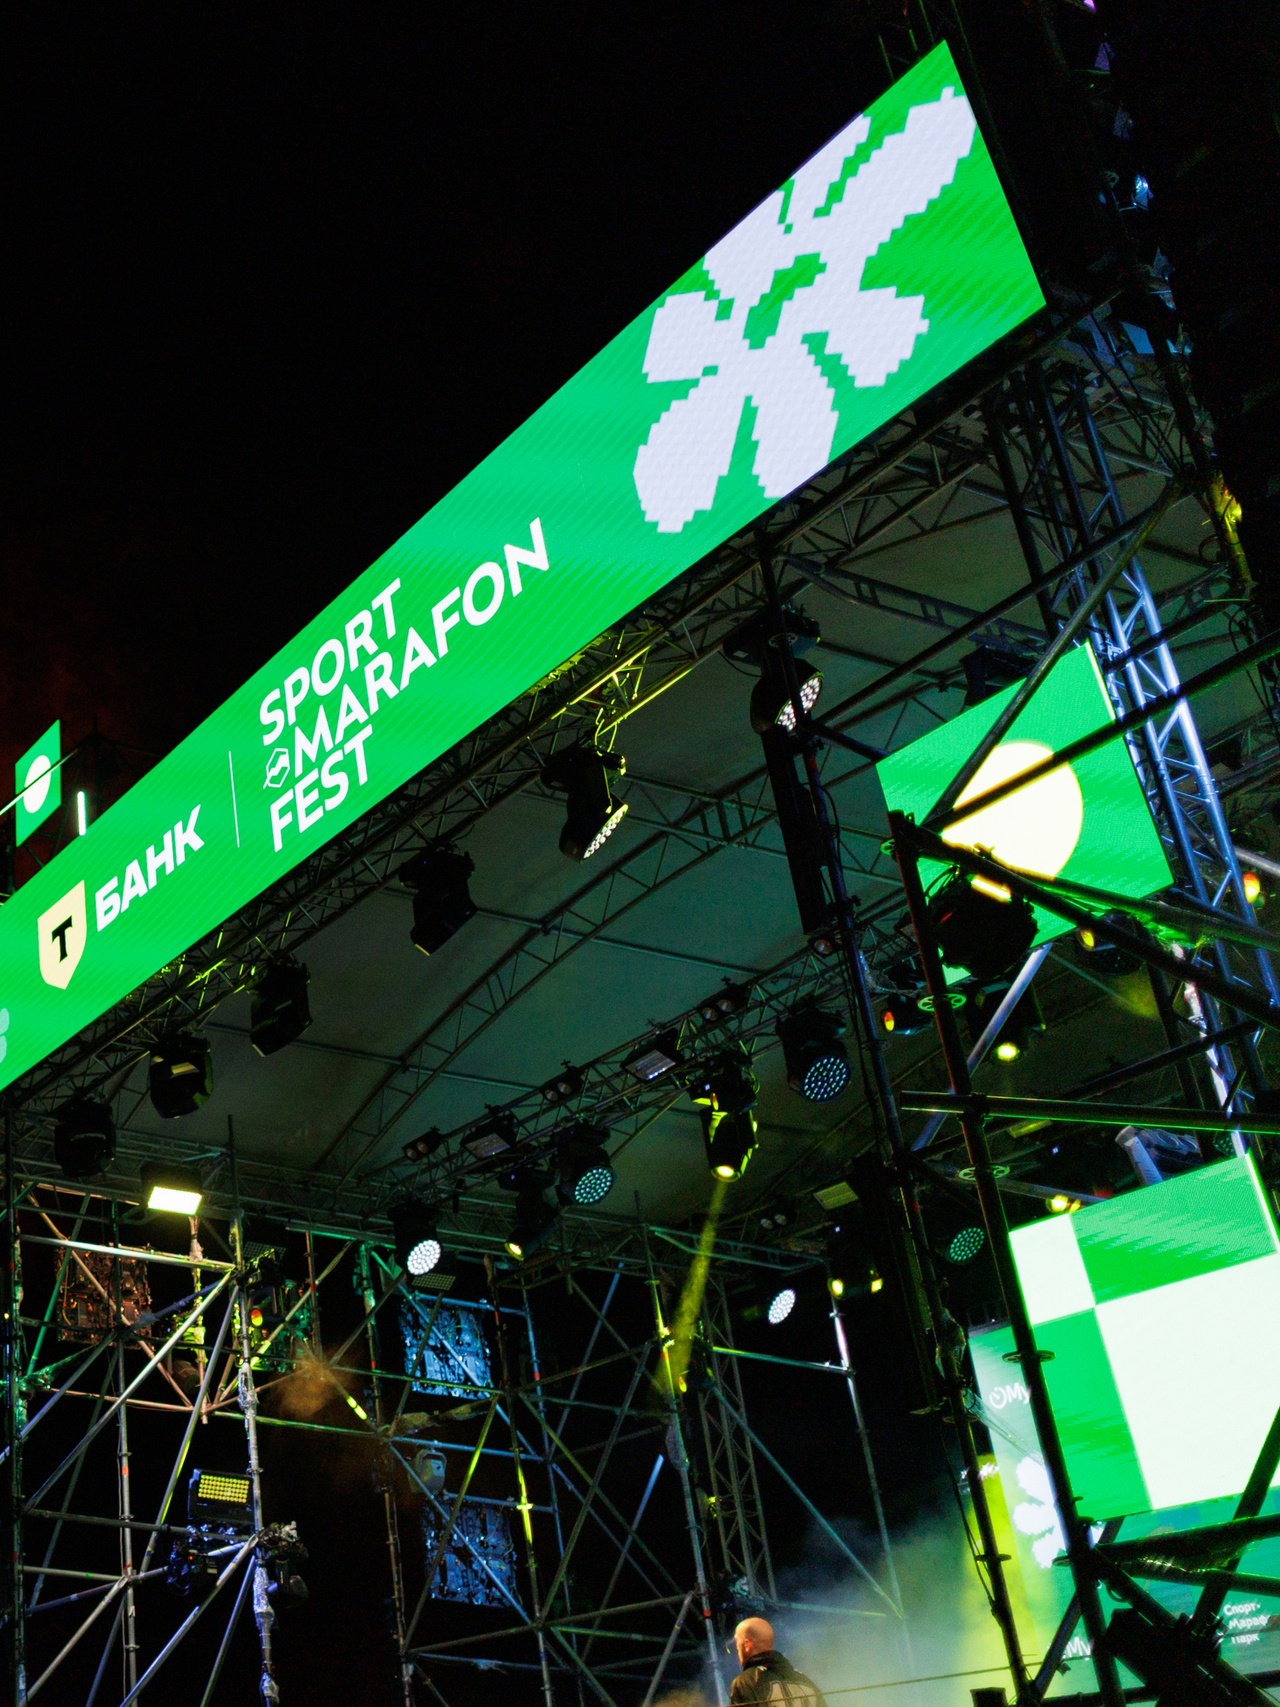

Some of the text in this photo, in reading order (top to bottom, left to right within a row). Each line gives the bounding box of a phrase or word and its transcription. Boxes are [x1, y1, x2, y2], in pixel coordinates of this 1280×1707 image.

[258, 577, 401, 746] SPORT
[294, 517, 550, 778] MARAFON
[270, 724, 373, 853] FEST
[94, 804, 205, 932] БАНК
